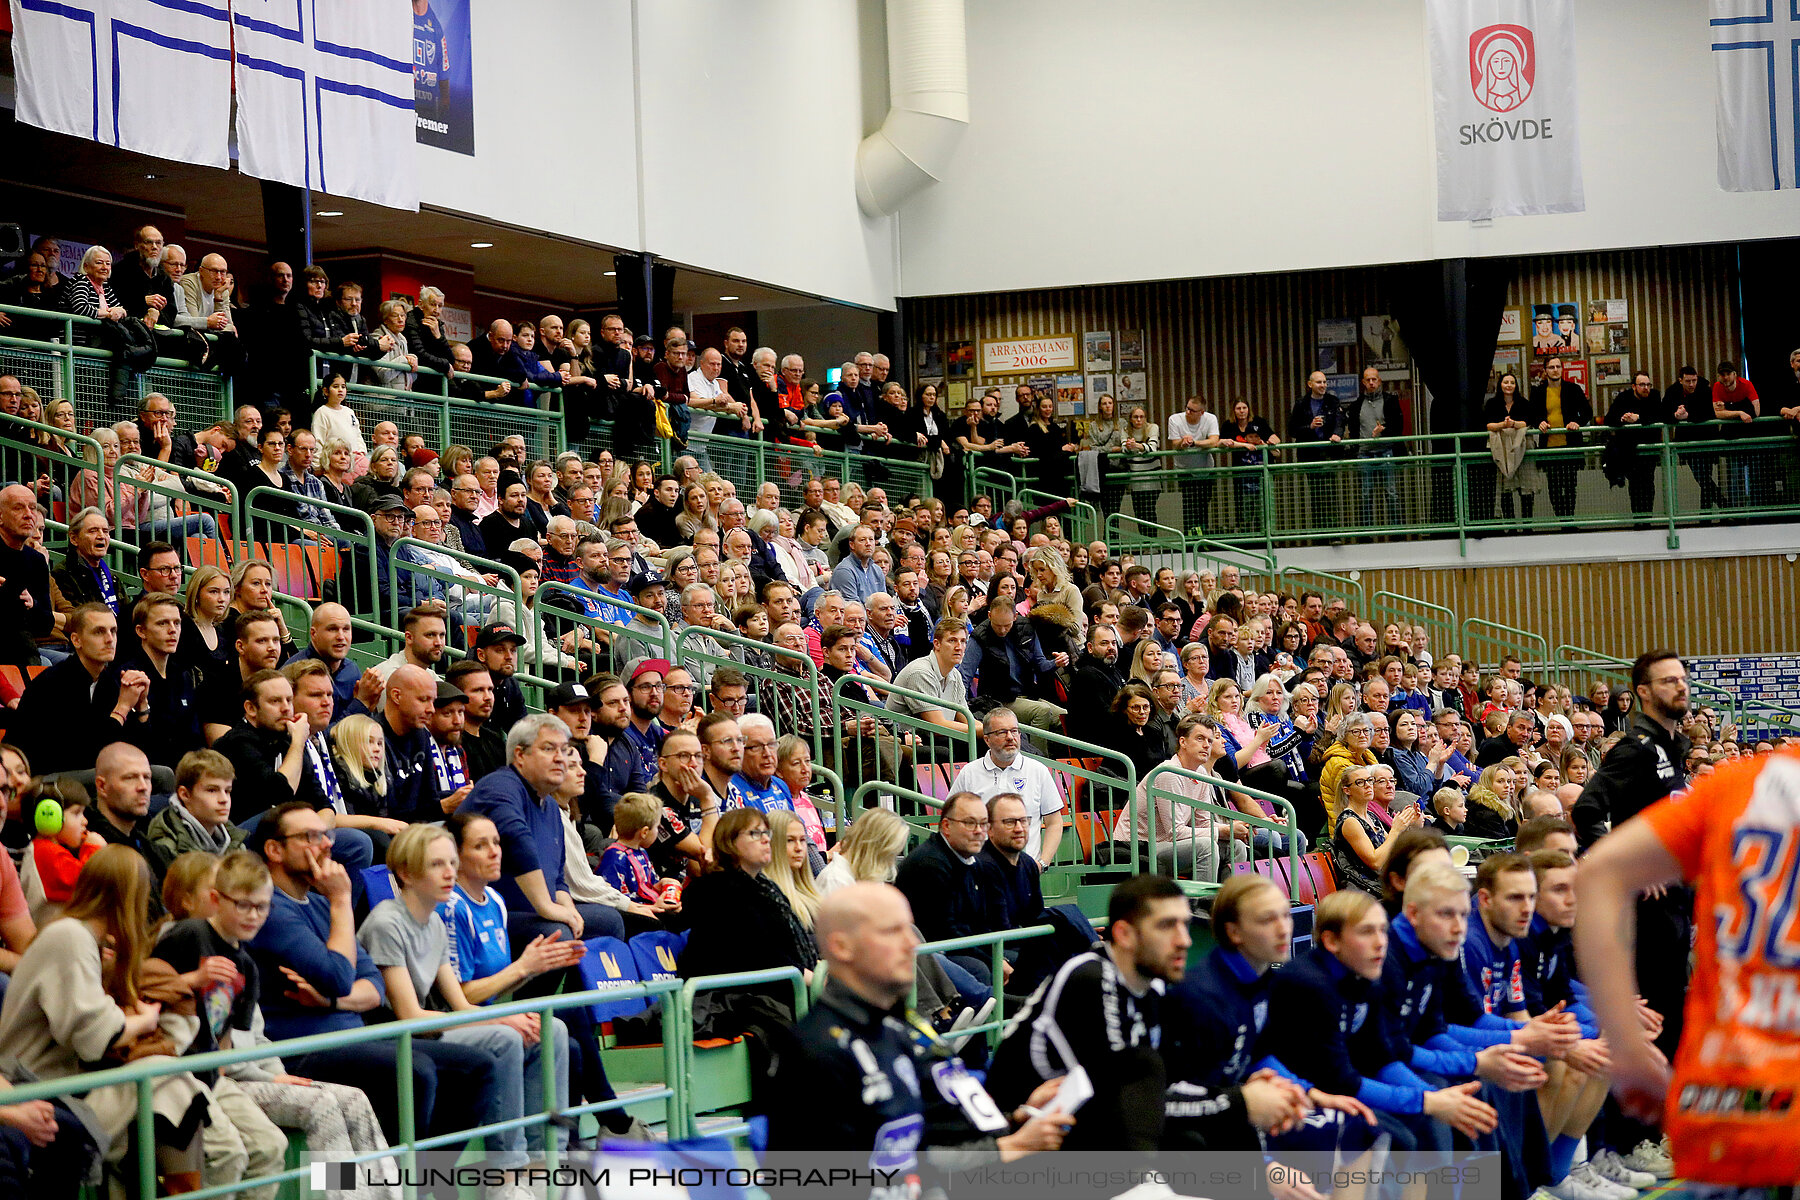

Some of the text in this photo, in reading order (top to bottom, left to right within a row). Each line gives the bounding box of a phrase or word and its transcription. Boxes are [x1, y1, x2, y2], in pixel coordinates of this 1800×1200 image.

[416, 114, 449, 134] remer
[1459, 117, 1552, 145] SKÖVDE
[990, 341, 1069, 357] ARRANGEMANG
[1013, 355, 1047, 367] 2006
[1770, 714, 1791, 723] ATG
